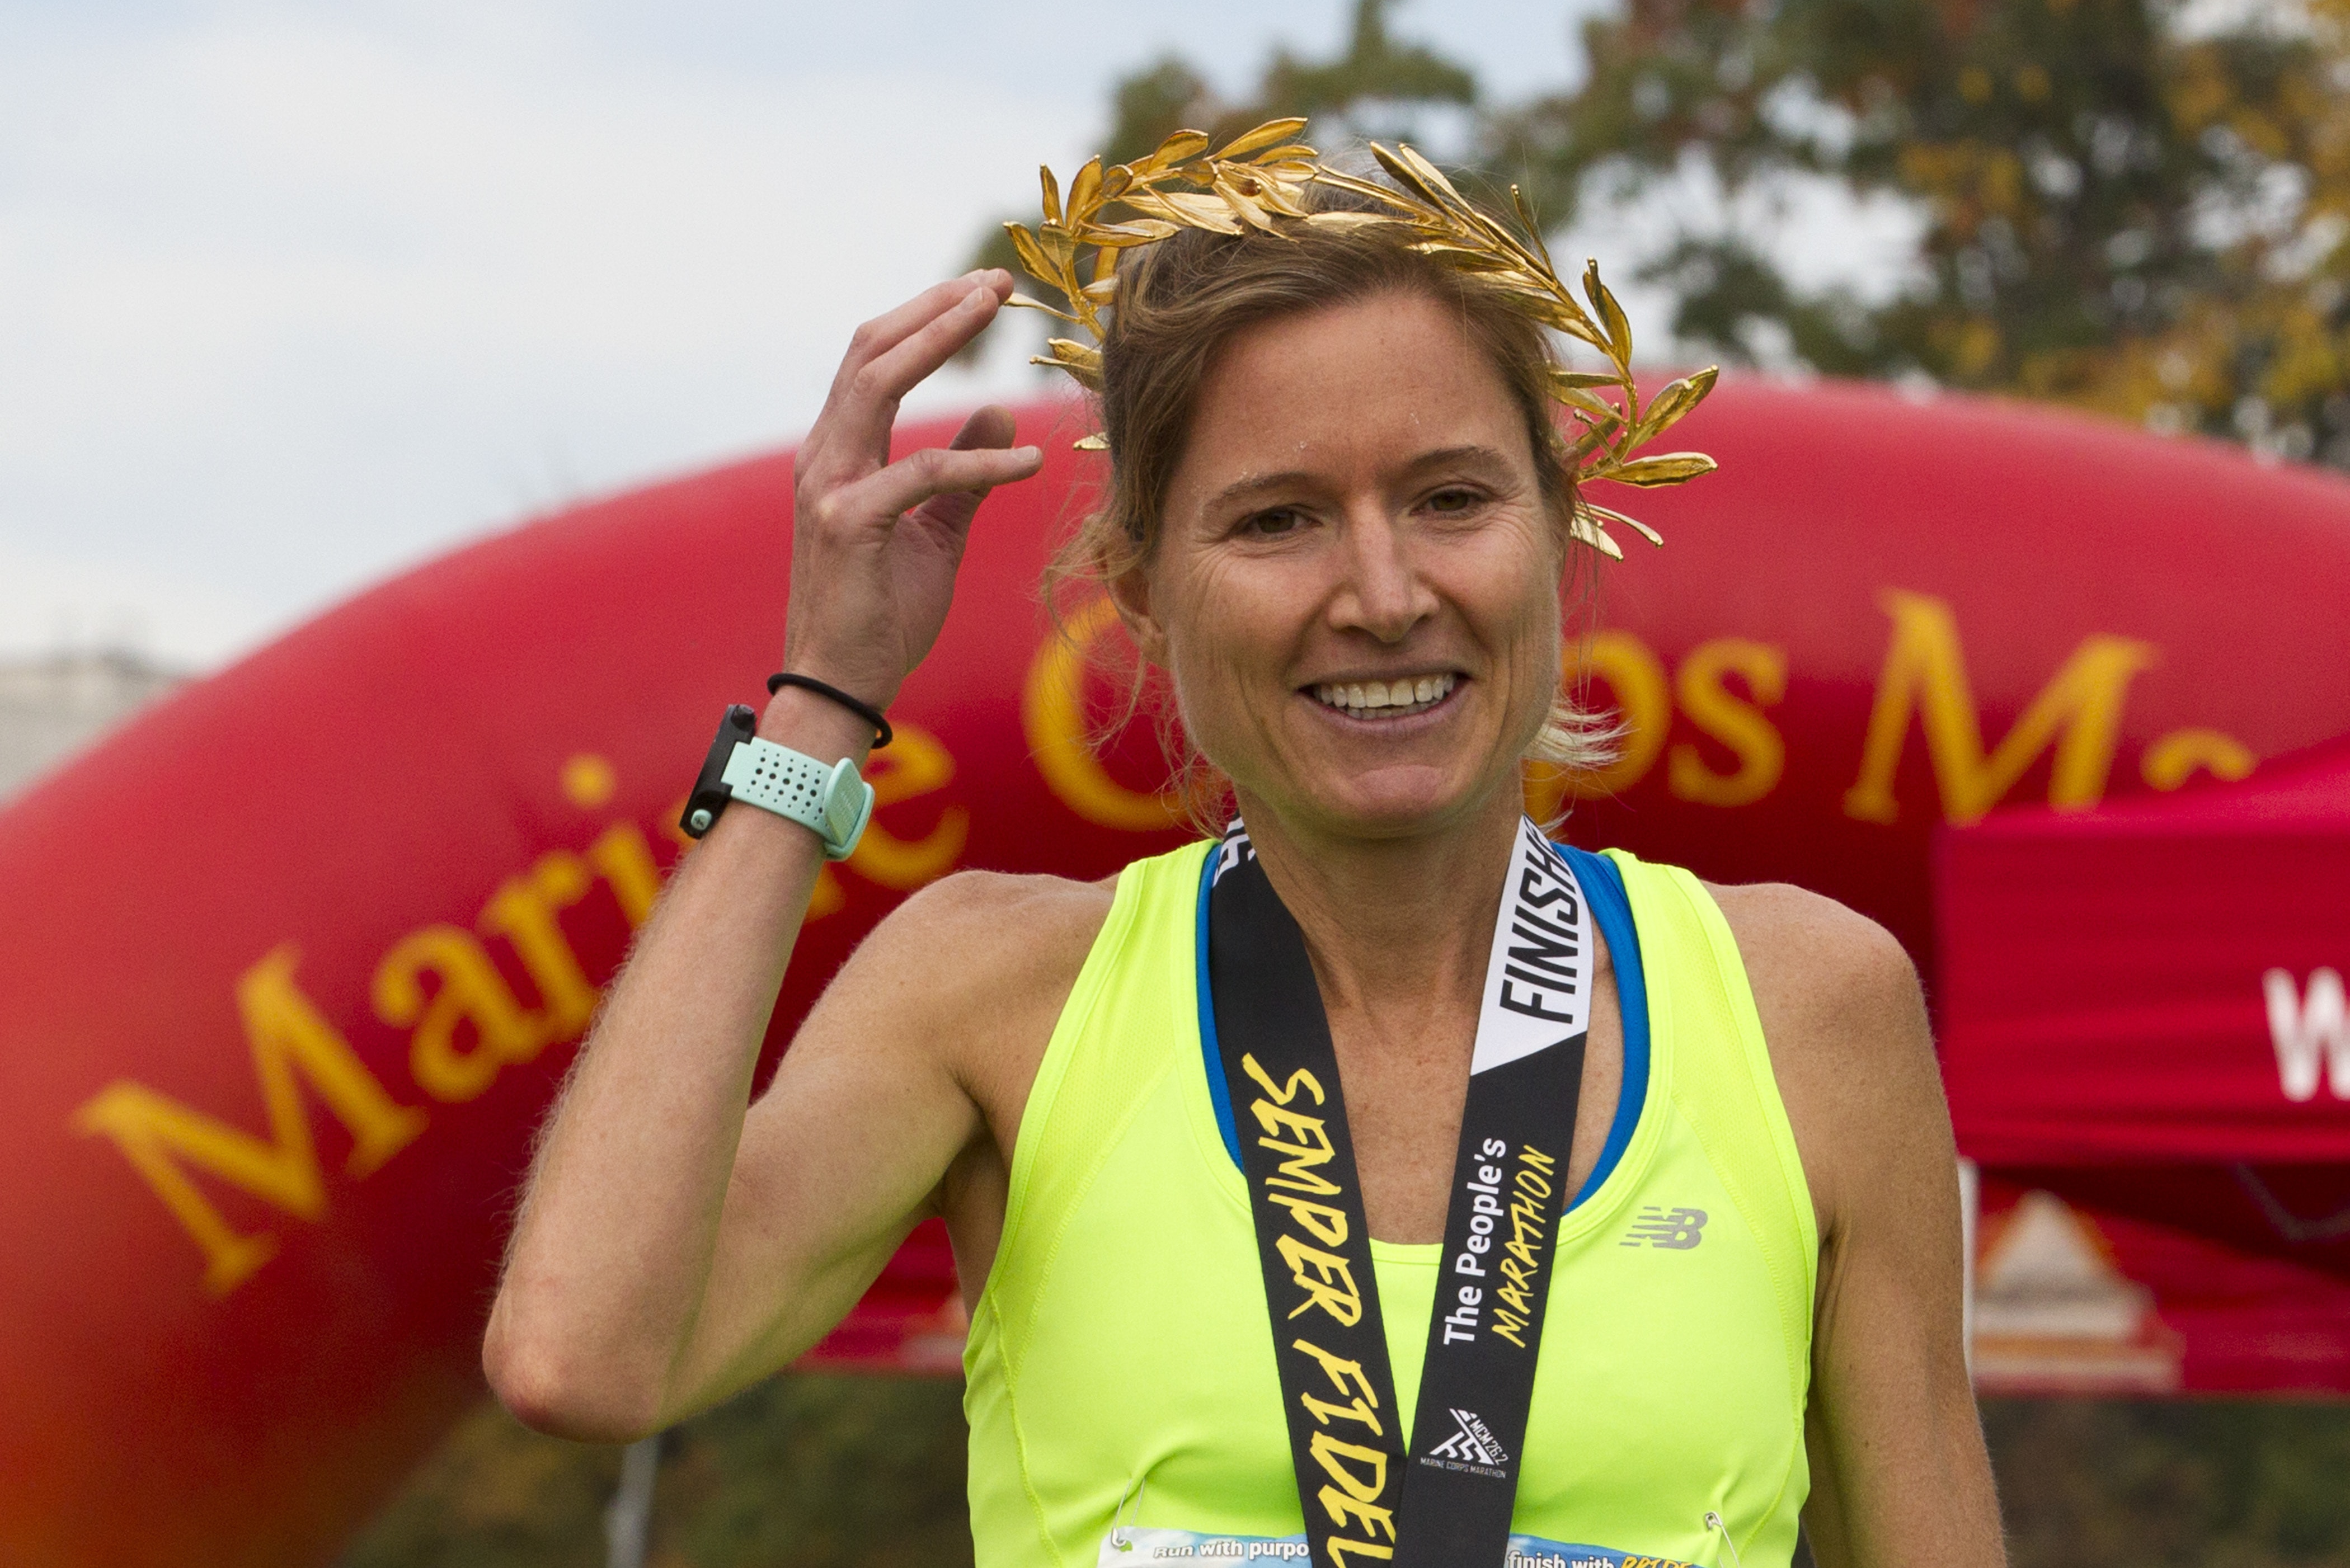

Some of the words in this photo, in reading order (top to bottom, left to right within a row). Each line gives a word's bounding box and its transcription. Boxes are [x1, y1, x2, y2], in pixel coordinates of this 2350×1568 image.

[77, 723, 968, 1298] Marie
[1242, 1052, 1362, 1327] SEMPER
[1455, 1138, 1506, 1277] People's
[1492, 1144, 1555, 1348] MARATHON
[1444, 1286, 1482, 1345] The
[1420, 1457, 1445, 1468] MARINE
[1446, 1461, 1469, 1472] CORPS
[1470, 1465, 1506, 1478] MARATHON
[1154, 1546, 1194, 1558] Run
[1200, 1541, 1243, 1556] with
[1508, 1551, 1566, 1568] finish
